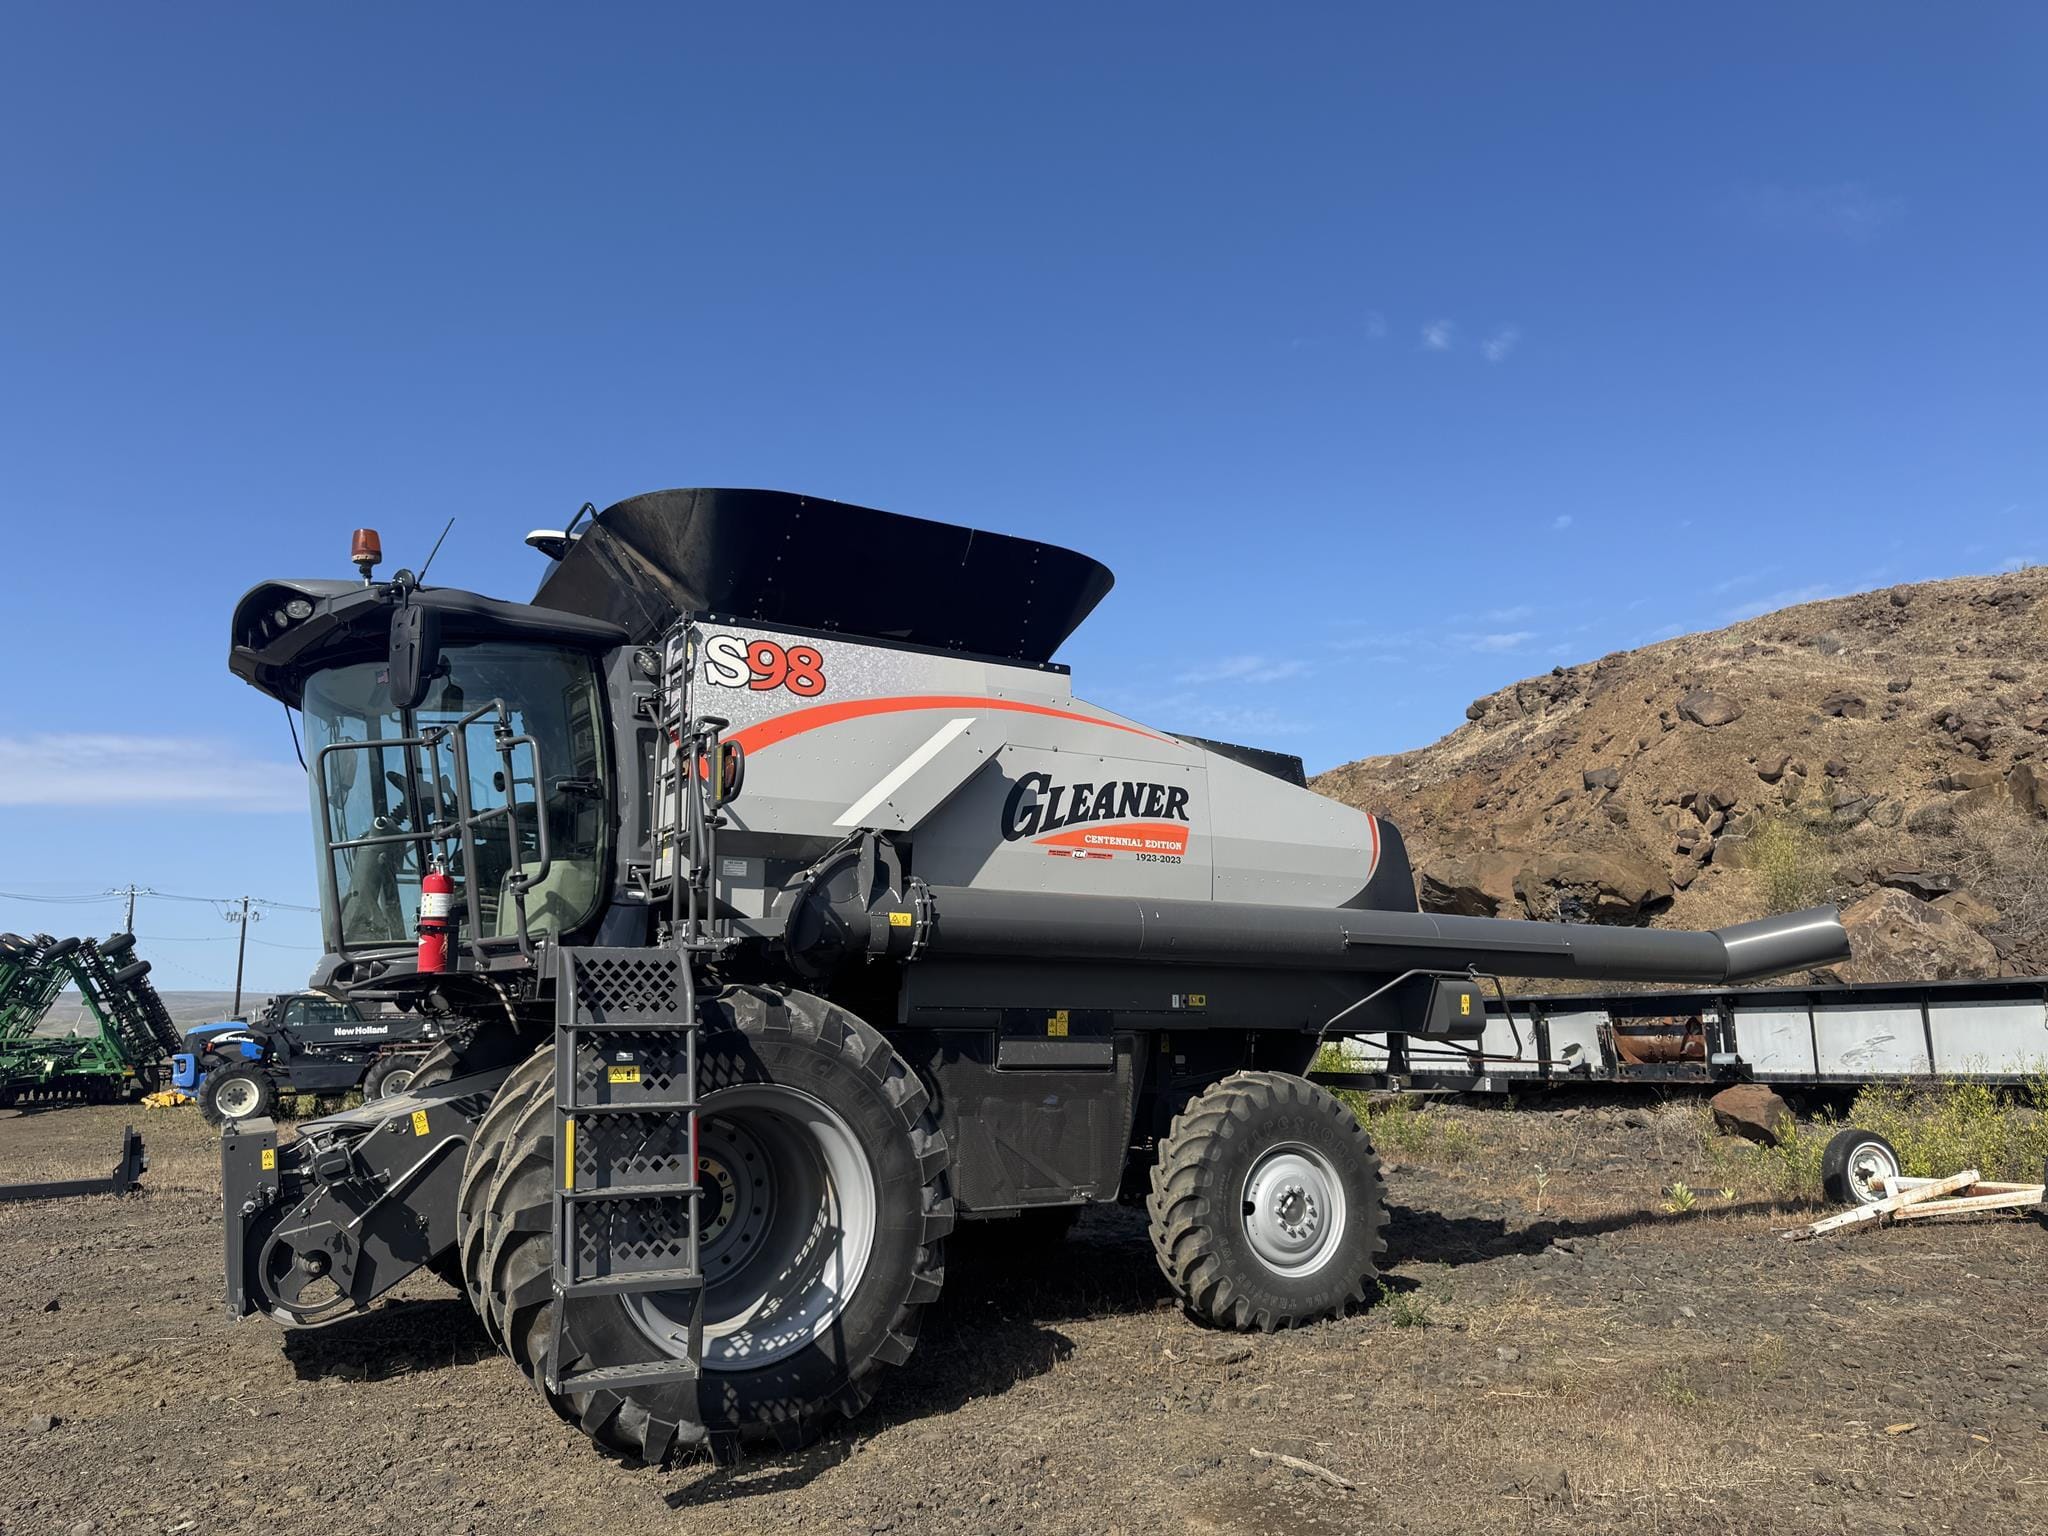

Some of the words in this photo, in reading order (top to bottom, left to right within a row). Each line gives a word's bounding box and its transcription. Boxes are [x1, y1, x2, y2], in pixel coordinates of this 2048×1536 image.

[705, 634, 826, 697] S98
[1001, 771, 1190, 842] GLEANER
[1084, 834, 1142, 848] CENTENNIAL
[1145, 840, 1182, 850] EDITION
[1136, 853, 1182, 864] 1923-2023
[334, 1026, 355, 1036] New
[355, 1025, 388, 1035] Holland
